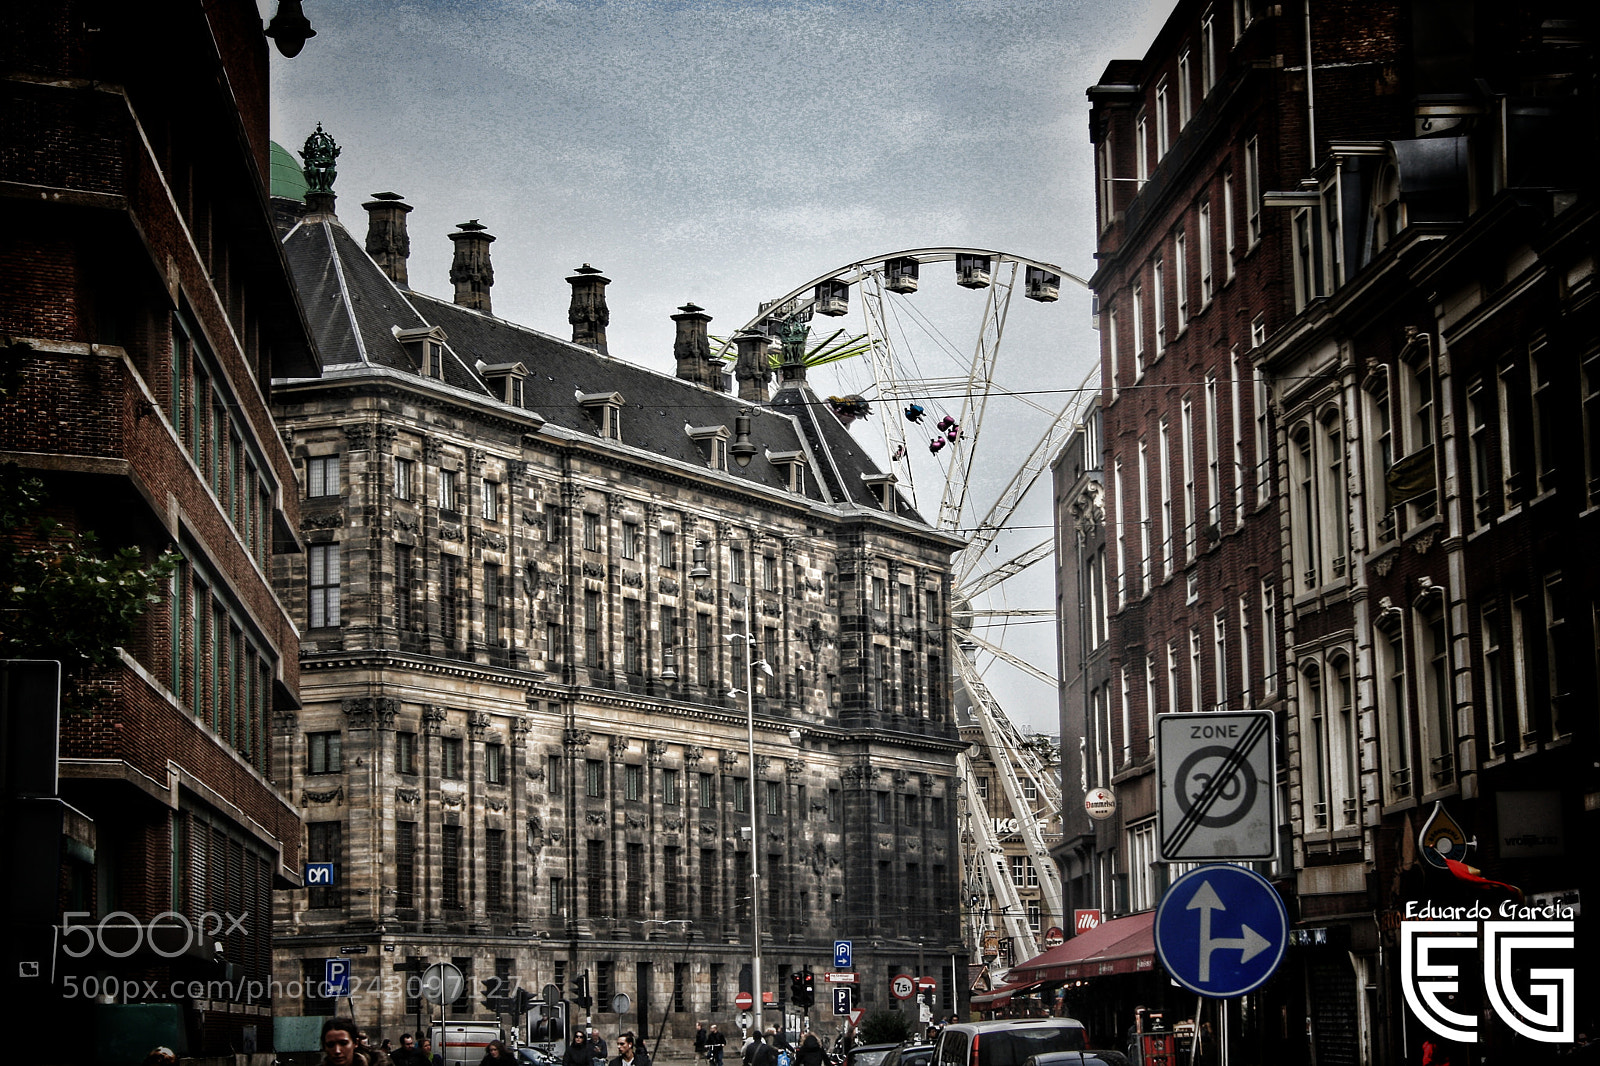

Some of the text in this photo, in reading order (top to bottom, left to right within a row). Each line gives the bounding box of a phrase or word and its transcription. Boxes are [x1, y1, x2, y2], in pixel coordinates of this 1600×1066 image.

[1190, 725, 1239, 739] ZONE
[1192, 773, 1240, 801] 30
[331, 963, 345, 981] P
[838, 992, 846, 1003] P
